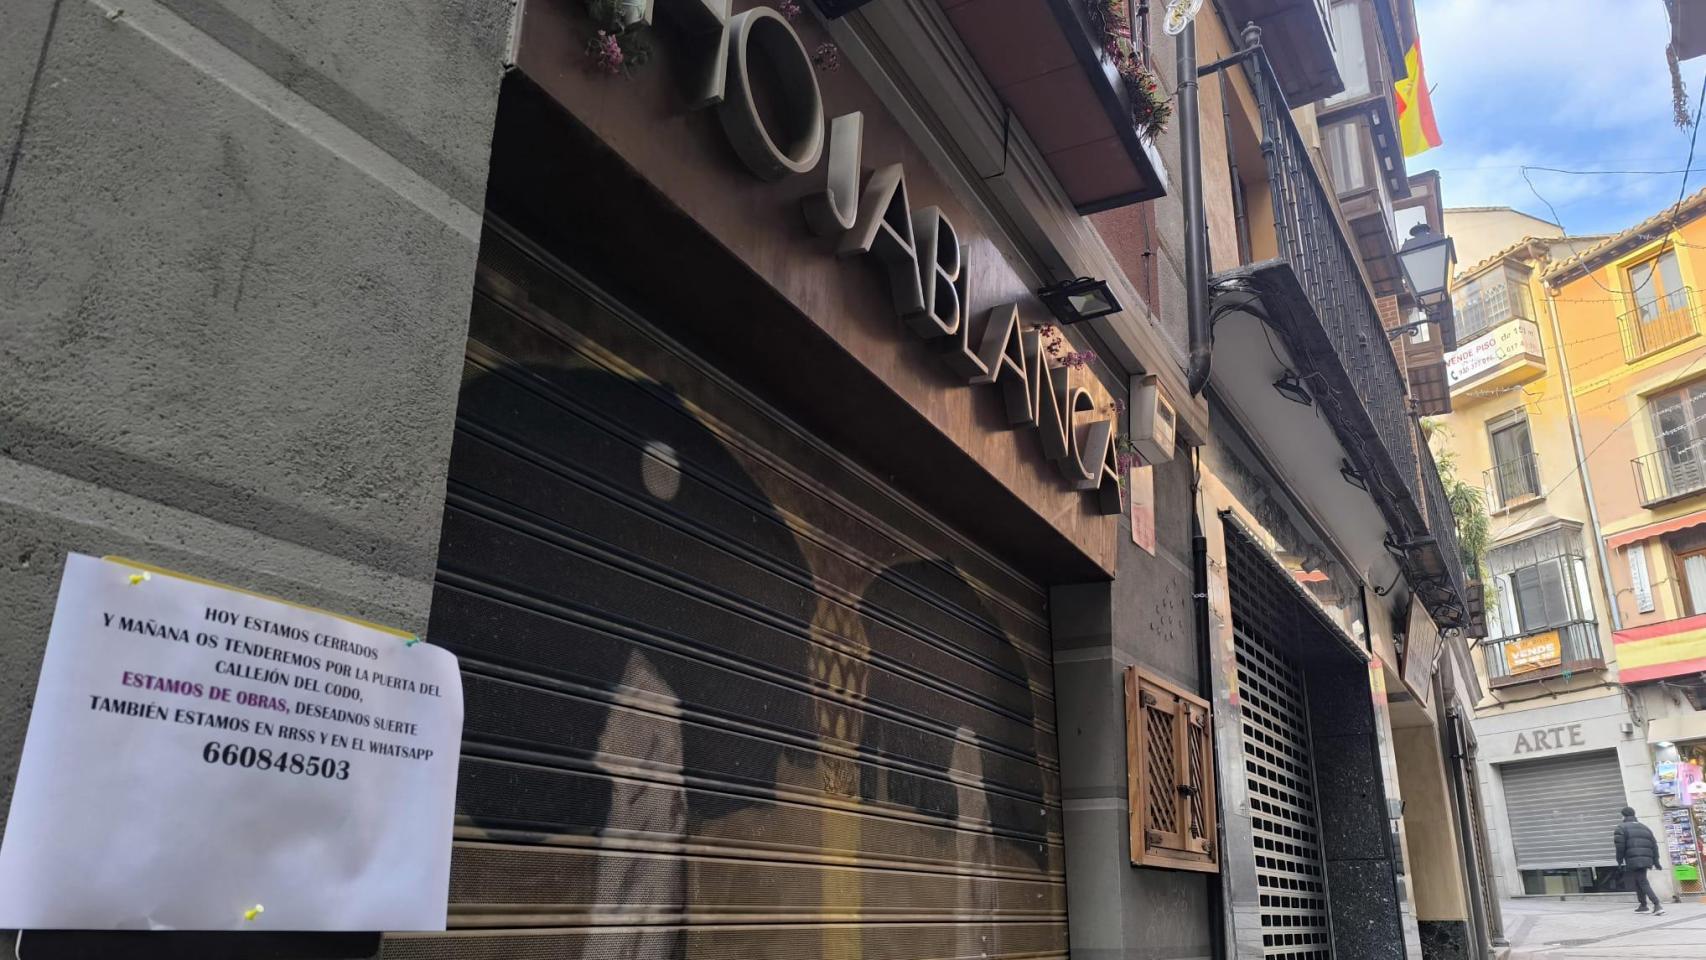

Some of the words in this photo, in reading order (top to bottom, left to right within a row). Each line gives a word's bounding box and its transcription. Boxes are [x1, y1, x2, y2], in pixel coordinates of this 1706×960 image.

[1446, 351, 1474, 367] VENDE
[1476, 339, 1497, 353] PISO
[103, 612, 115, 627] Y
[118, 616, 190, 643] MAÑANA
[196, 632, 219, 648] OS
[224, 637, 321, 670] TENDEREMOS
[325, 660, 352, 677] POR
[355, 667, 369, 682] LA
[372, 672, 415, 692] PUERTA
[419, 682, 441, 697] DEL
[204, 607, 240, 626] HOY
[243, 616, 310, 643] ESTAMOS
[314, 633, 378, 660] CERRADOS
[1512, 643, 1555, 659] VENDE
[215, 660, 290, 686] CALLEJÓN
[293, 675, 320, 692] DEL
[324, 682, 363, 703] CODO,
[121, 671, 204, 698] ESTAMOS
[208, 685, 232, 703] DE
[236, 691, 290, 714] OBRAS,
[295, 701, 370, 727] DESEADNOS
[373, 717, 418, 736] SUERTE
[89, 694, 169, 720] TAMBIÉN
[174, 708, 250, 733] ESTAMOS
[254, 721, 274, 736] EN
[278, 725, 315, 743] RRSS
[320, 732, 328, 745] Y
[331, 734, 348, 748] EN
[351, 737, 366, 752] EL
[369, 740, 434, 761] WHATSAPP
[1513, 724, 1585, 753] ARTE
[202, 741, 350, 780] 660848503
